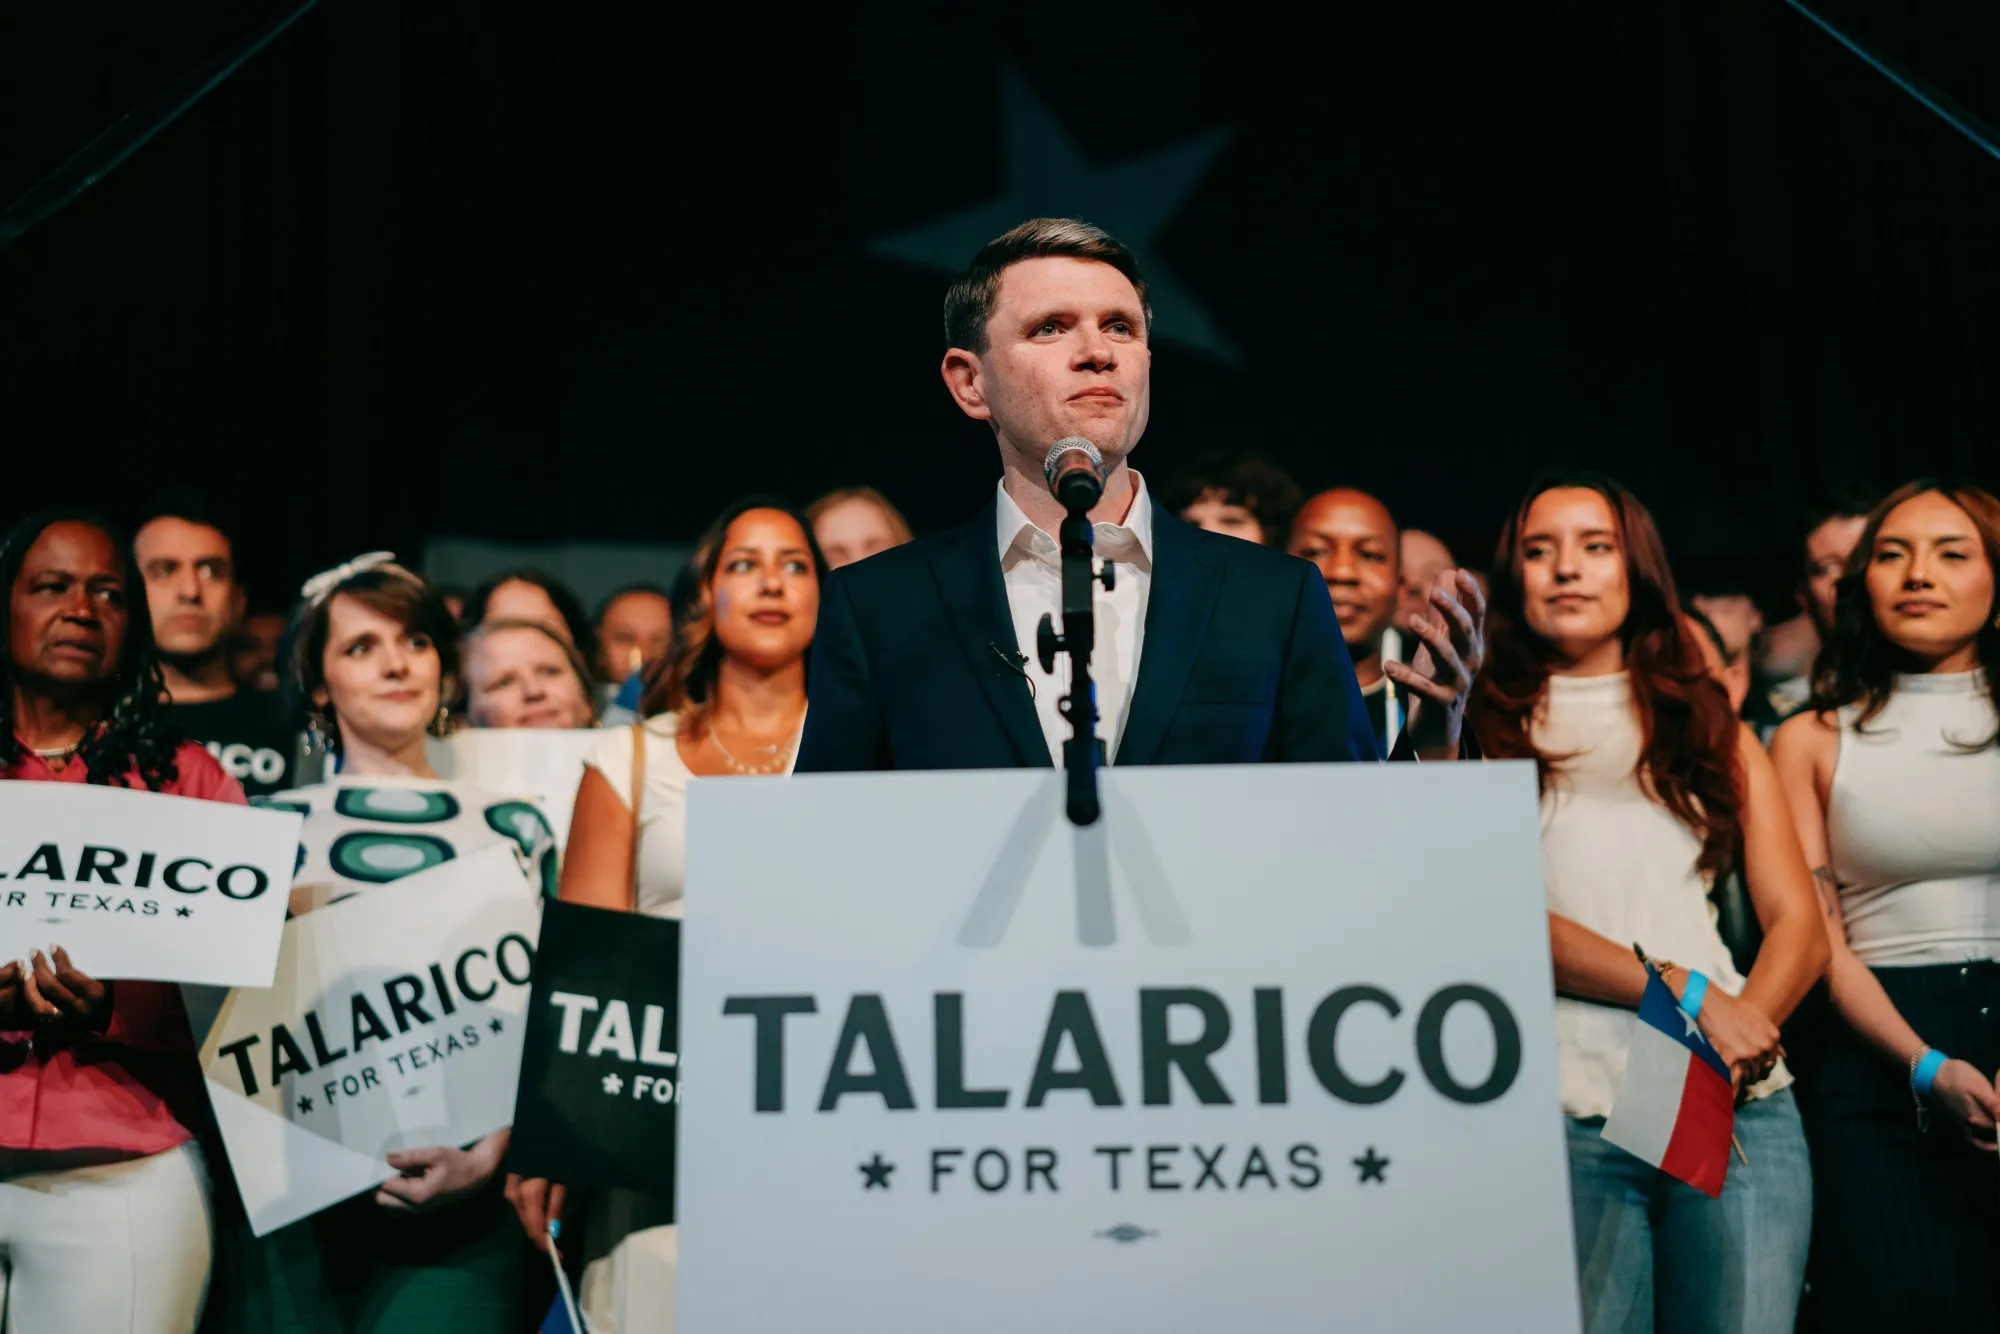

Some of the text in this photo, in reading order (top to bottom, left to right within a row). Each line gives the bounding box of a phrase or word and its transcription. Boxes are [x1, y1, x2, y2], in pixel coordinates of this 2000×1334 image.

[46, 892, 159, 916] TEXAS
[218, 932, 534, 1098] TALARICO
[323, 1024, 481, 1105] FOR TEXAS
[721, 982, 1523, 1114] TALARICO
[632, 1074, 681, 1105] FO
[929, 1144, 1325, 1194] FOR TEXAS
